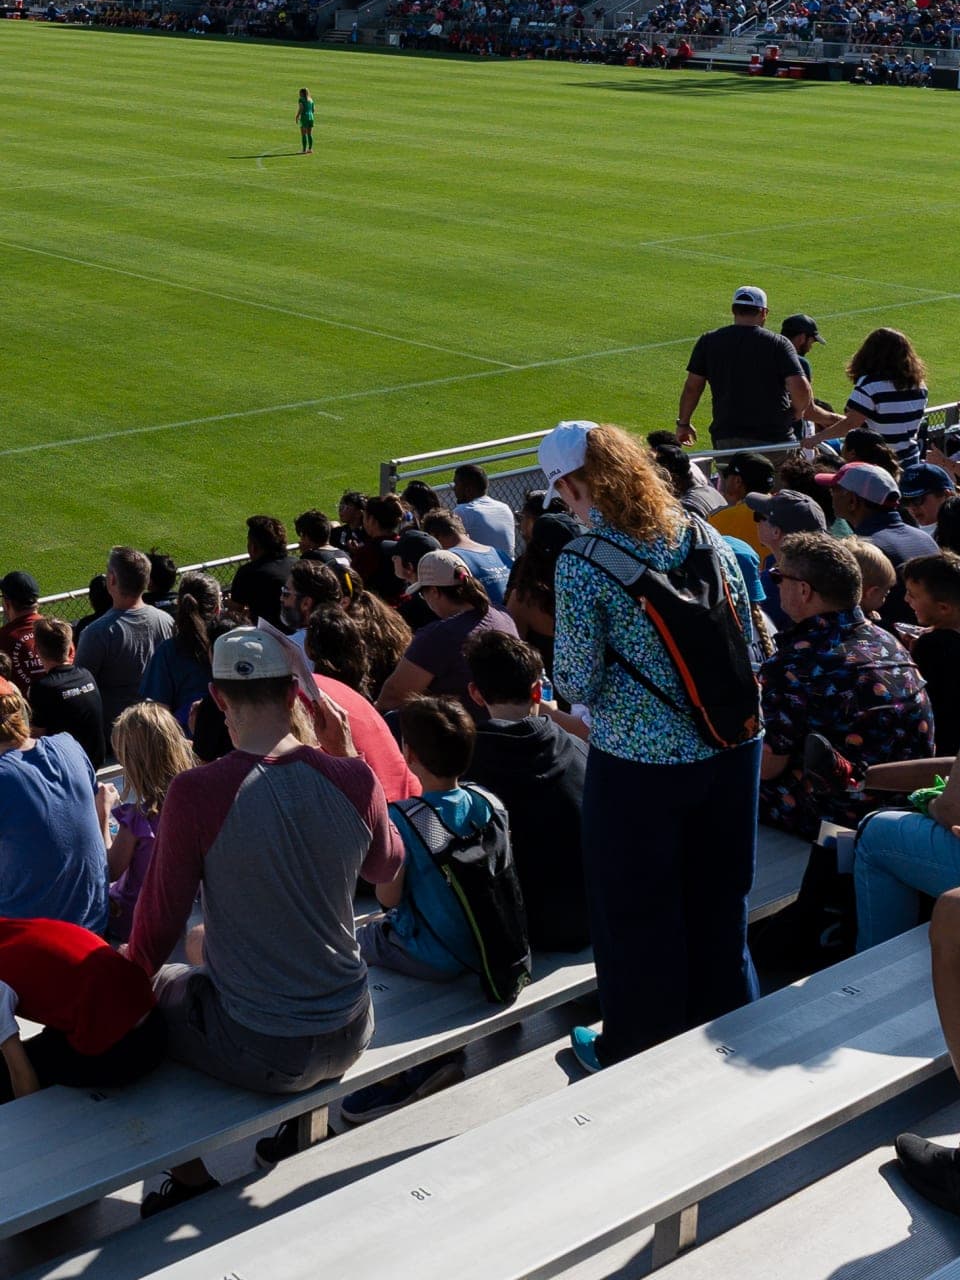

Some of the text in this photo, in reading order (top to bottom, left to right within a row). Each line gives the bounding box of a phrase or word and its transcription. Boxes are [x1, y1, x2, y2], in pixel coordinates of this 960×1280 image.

[841, 985, 861, 996] 15
[715, 1045, 736, 1056] 16
[572, 1114, 592, 1126] 17
[410, 1187, 432, 1201] 18
